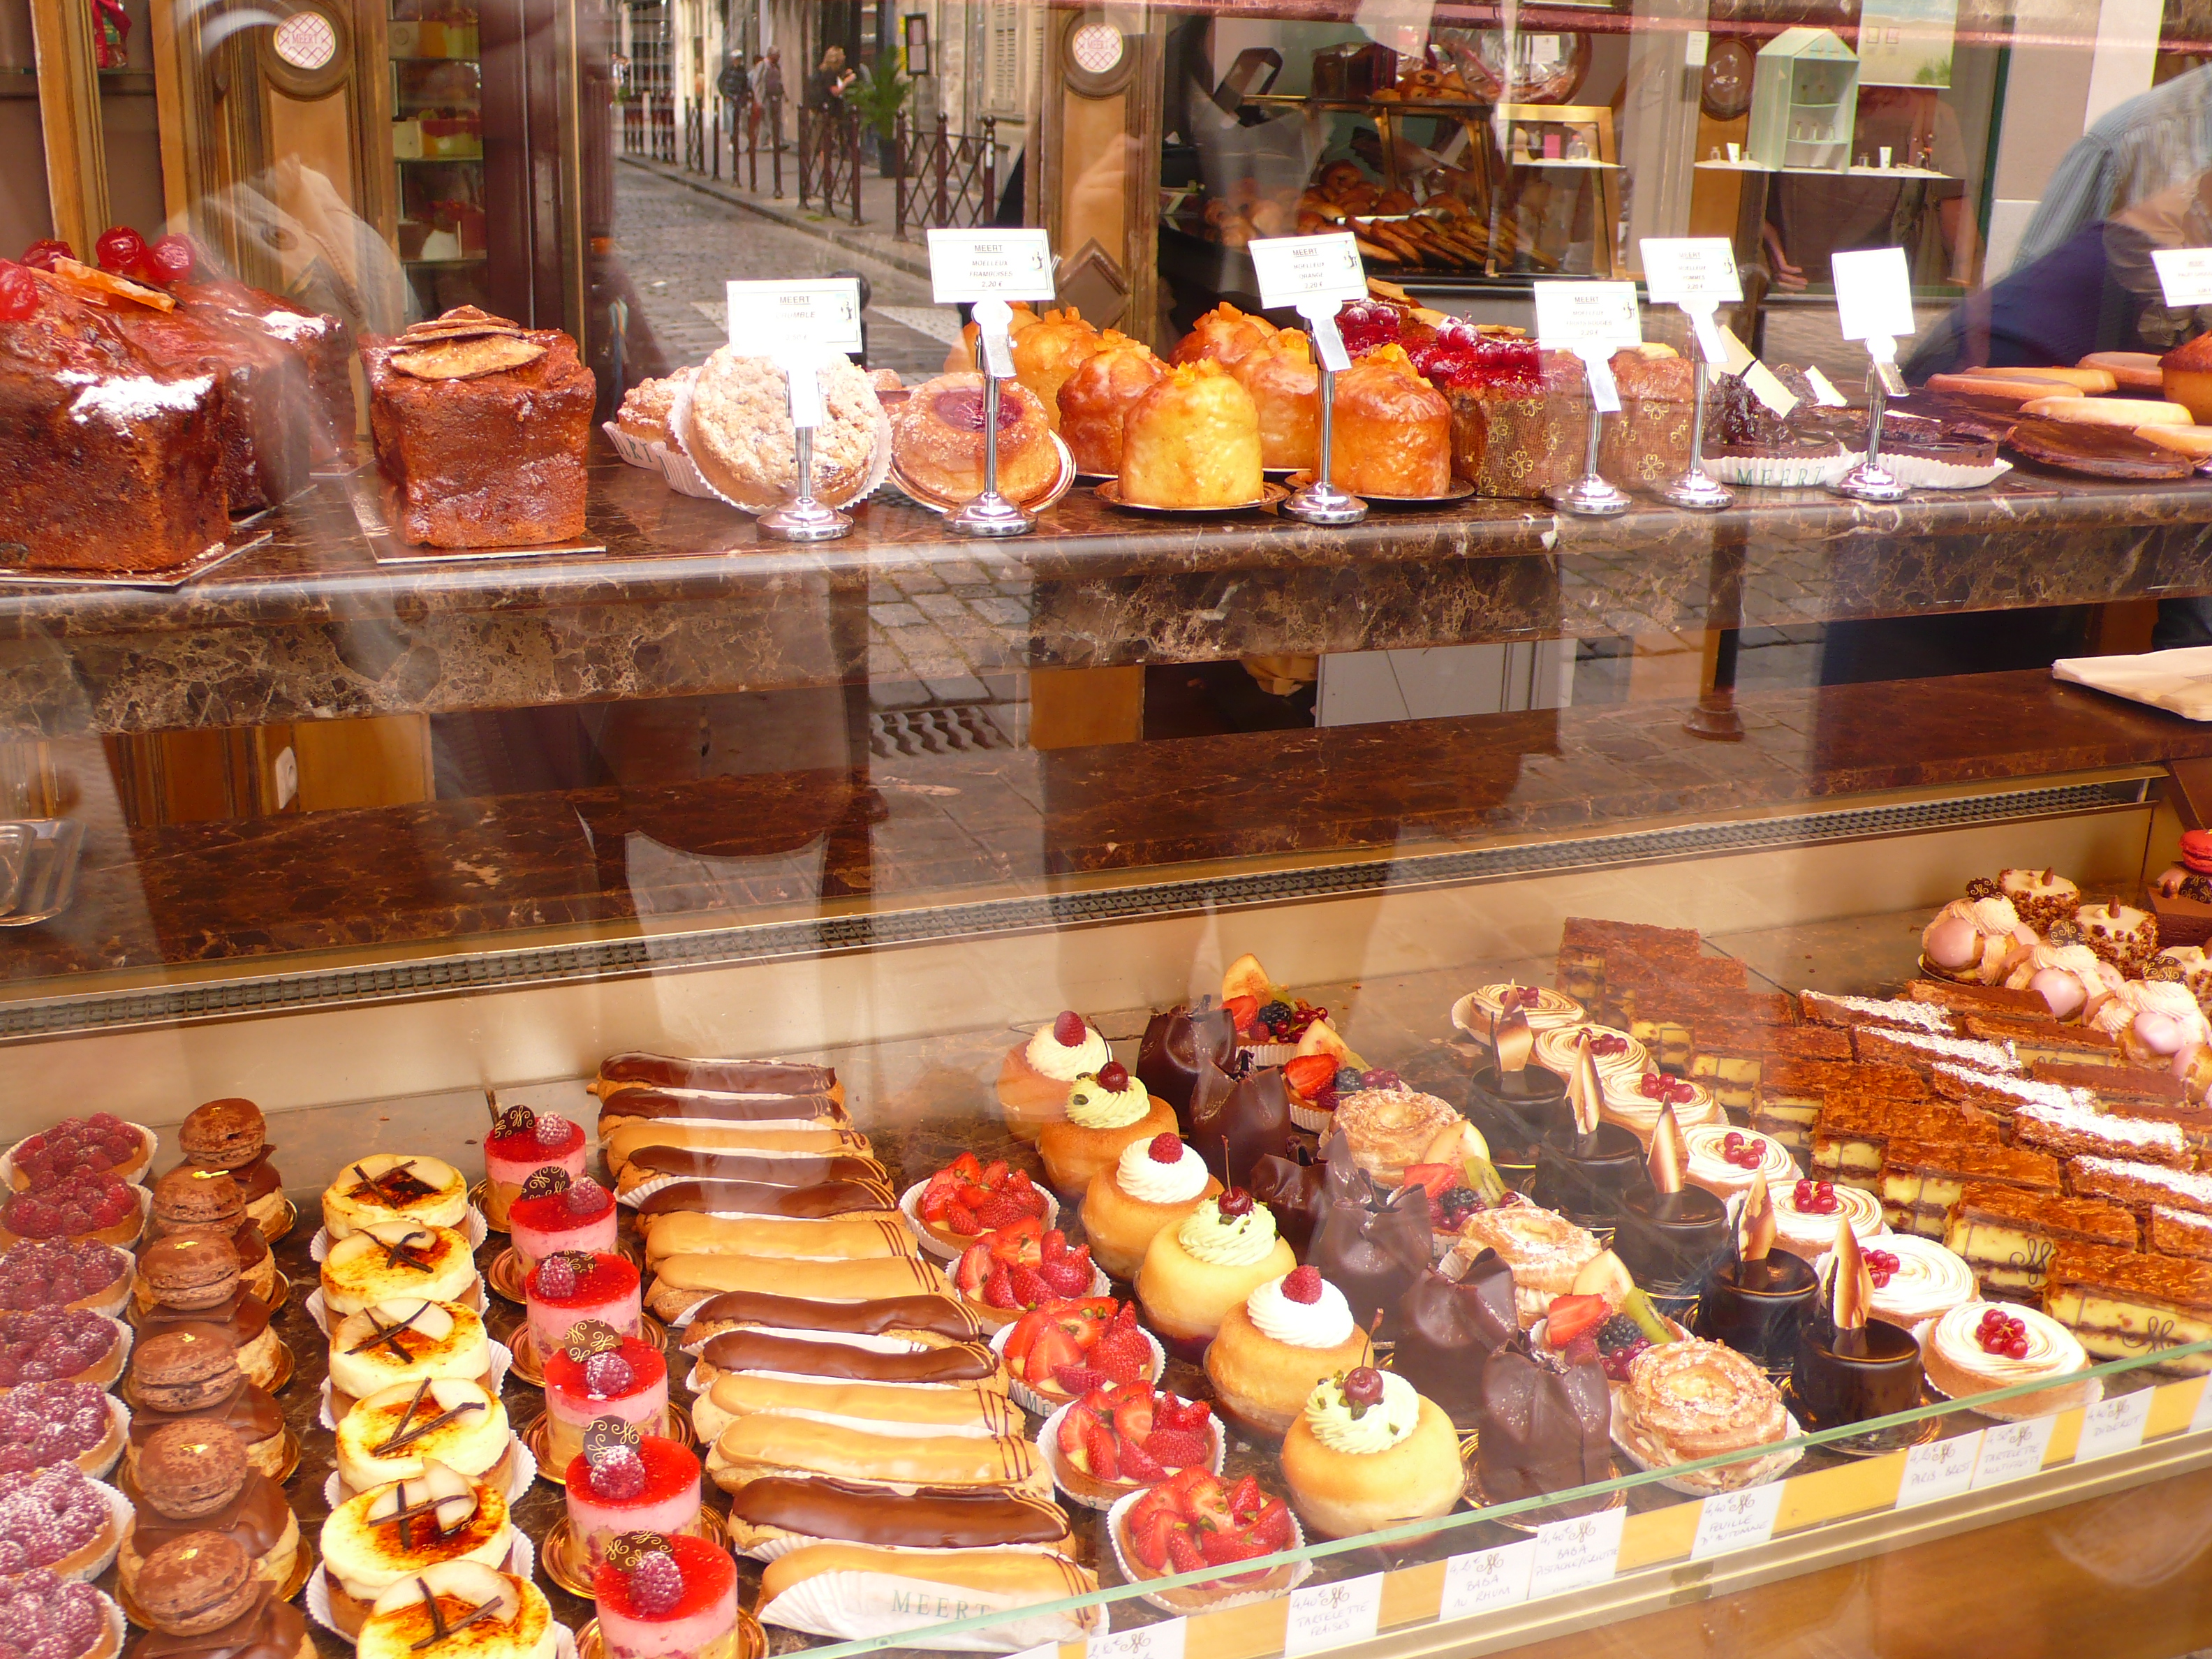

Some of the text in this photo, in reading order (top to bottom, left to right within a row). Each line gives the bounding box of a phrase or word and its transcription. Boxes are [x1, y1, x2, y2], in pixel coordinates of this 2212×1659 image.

[1293, 247, 1318, 256] MEERT
[779, 295, 811, 304] MEERT
[1557, 1544, 1588, 1560] BABA
[1467, 1575, 1498, 1591] BABA
[1476, 1586, 1510, 1603] RHUM
[1310, 1619, 1350, 1637] FRAISES
